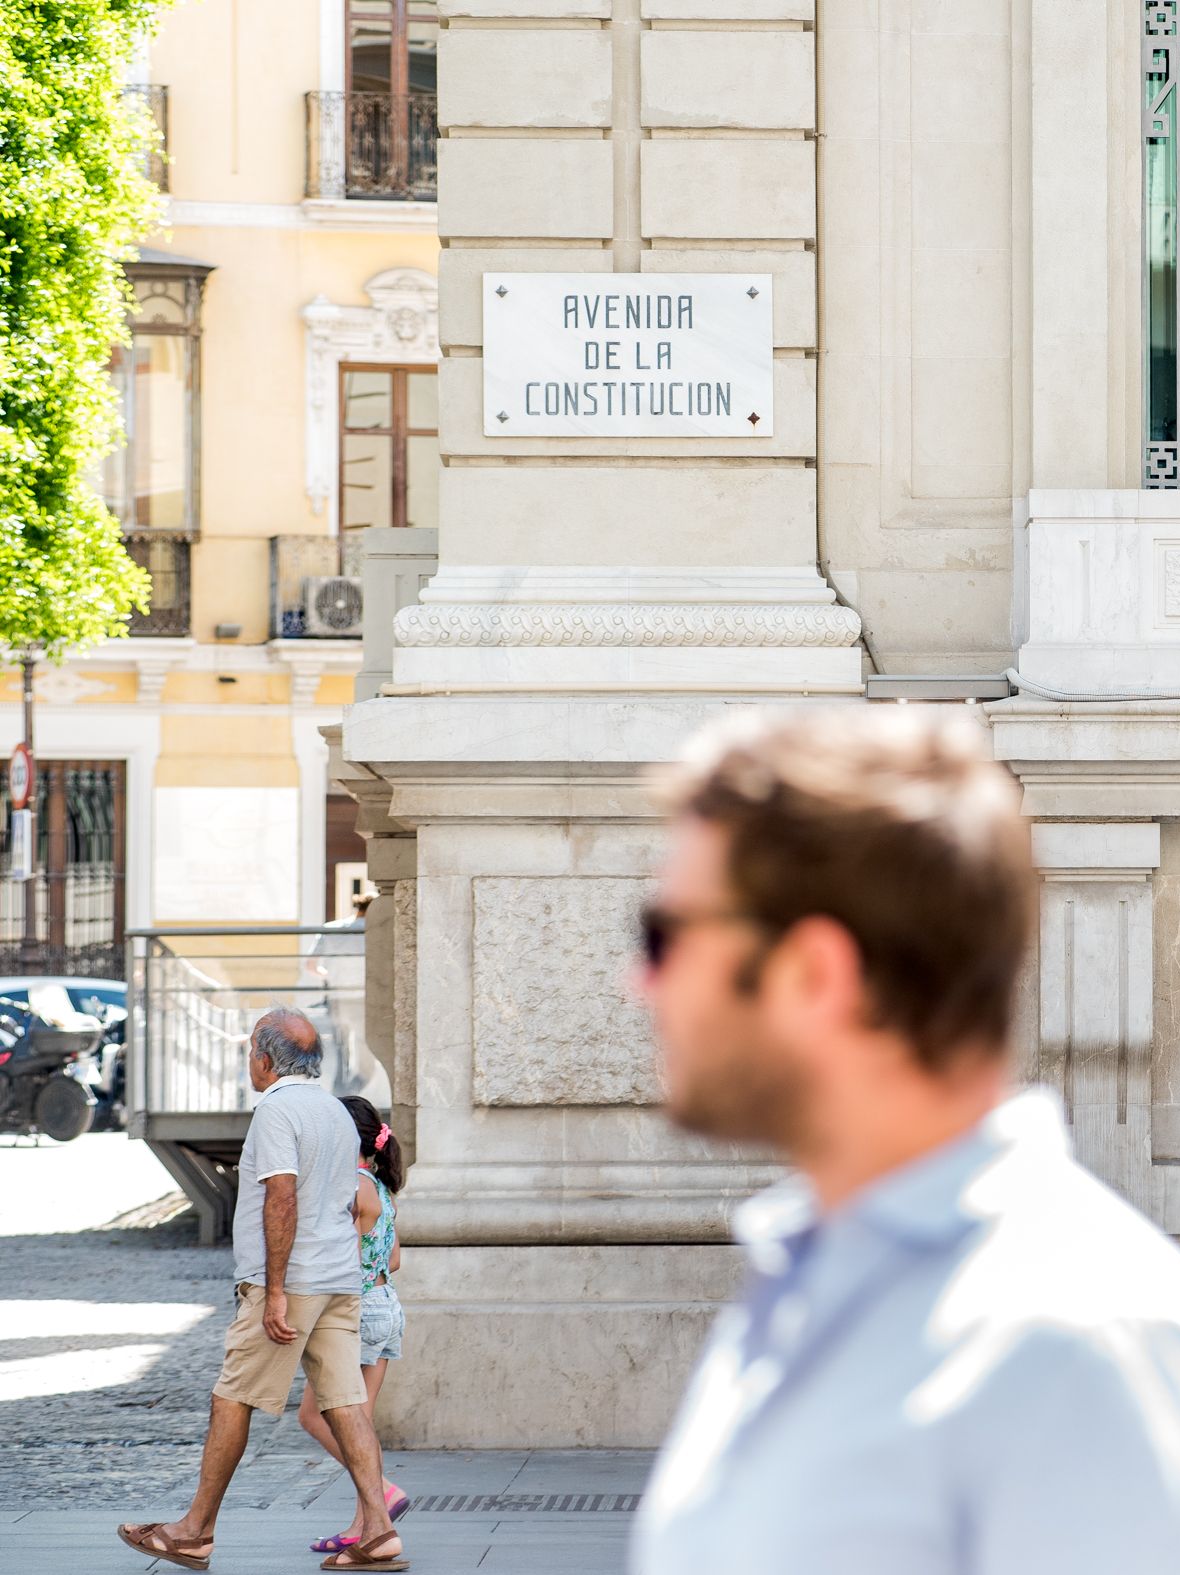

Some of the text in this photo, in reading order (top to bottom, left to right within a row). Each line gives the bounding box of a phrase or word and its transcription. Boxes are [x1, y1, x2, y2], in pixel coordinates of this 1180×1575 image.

[563, 294, 693, 329] AVENIDA
[584, 341, 672, 370] DE LA
[525, 382, 731, 416] CONSTITUCION
